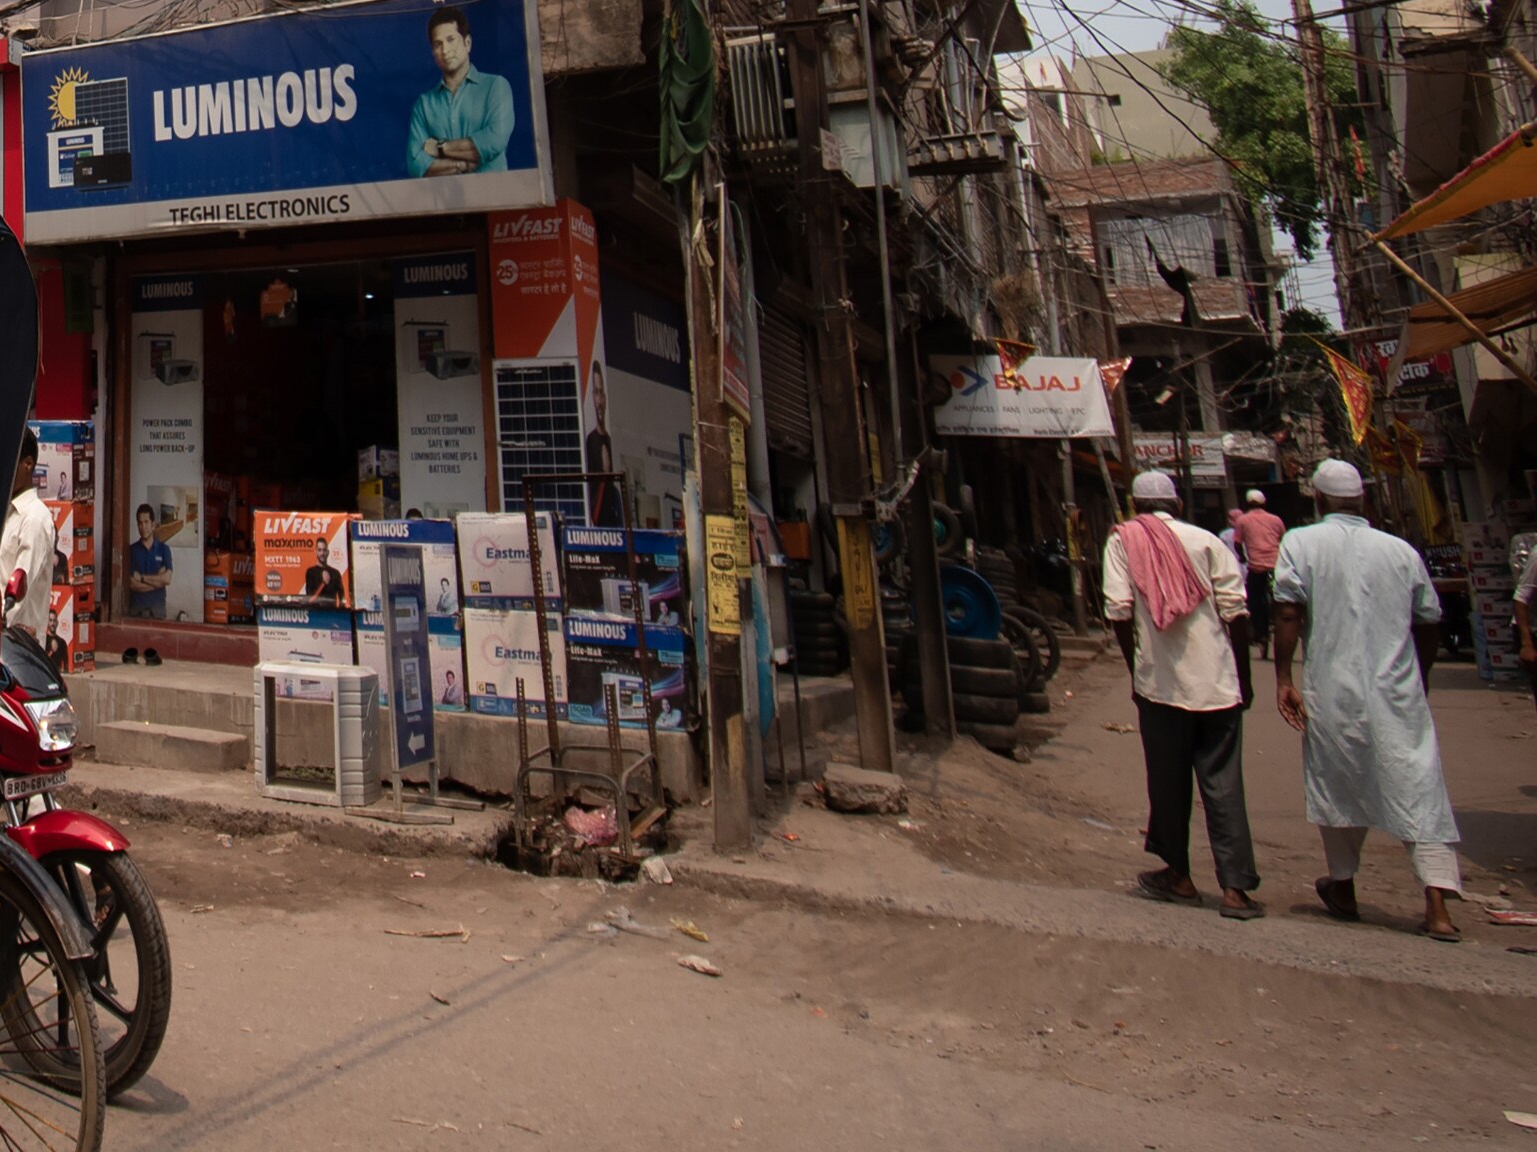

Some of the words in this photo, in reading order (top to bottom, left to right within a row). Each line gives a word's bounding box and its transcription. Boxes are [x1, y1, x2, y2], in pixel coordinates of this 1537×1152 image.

[153, 64, 358, 142] LUMINOUS
[225, 194, 351, 222] ELECTRONICS
[494, 215, 563, 238] LIVFAST
[404, 263, 468, 283] LUMINOUS
[142, 281, 193, 299] LUMINOUS
[994, 374, 1081, 392] BAJAJ
[954, 405, 994, 413] APPLIANCES
[1003, 405, 1020, 414] FANS
[1030, 405, 1063, 414] LIGHTING
[143, 419, 160, 428] POWER
[160, 419, 174, 427] PACK
[174, 419, 192, 427] COMBO
[426, 414, 441, 423] KEEP
[442, 413, 458, 423] YOUR
[150, 431, 162, 440] THAT
[163, 431, 185, 440] ASSURES
[411, 426, 440, 436] SENSITIVE
[442, 425, 475, 436] EQUIPMENT
[153, 444, 171, 453] POWER
[428, 439, 442, 448] SAFE
[444, 439, 459, 448] WITH
[411, 452, 440, 461] LUMINOUS
[442, 452, 459, 461] HOME
[460, 452, 471, 461] UPS
[429, 465, 461, 474] BATTERIES
[264, 512, 331, 534] LIVFAST
[358, 522, 409, 538] LUMINOUS
[264, 538, 313, 549] maxximo
[567, 530, 623, 547] LUMINOUS
[486, 547, 542, 560] Eastma
[388, 557, 421, 586] LUMINOUS
[263, 608, 310, 624] LUMINOUS
[569, 620, 626, 640] LUMINOUS
[495, 646, 551, 661] Eastma
